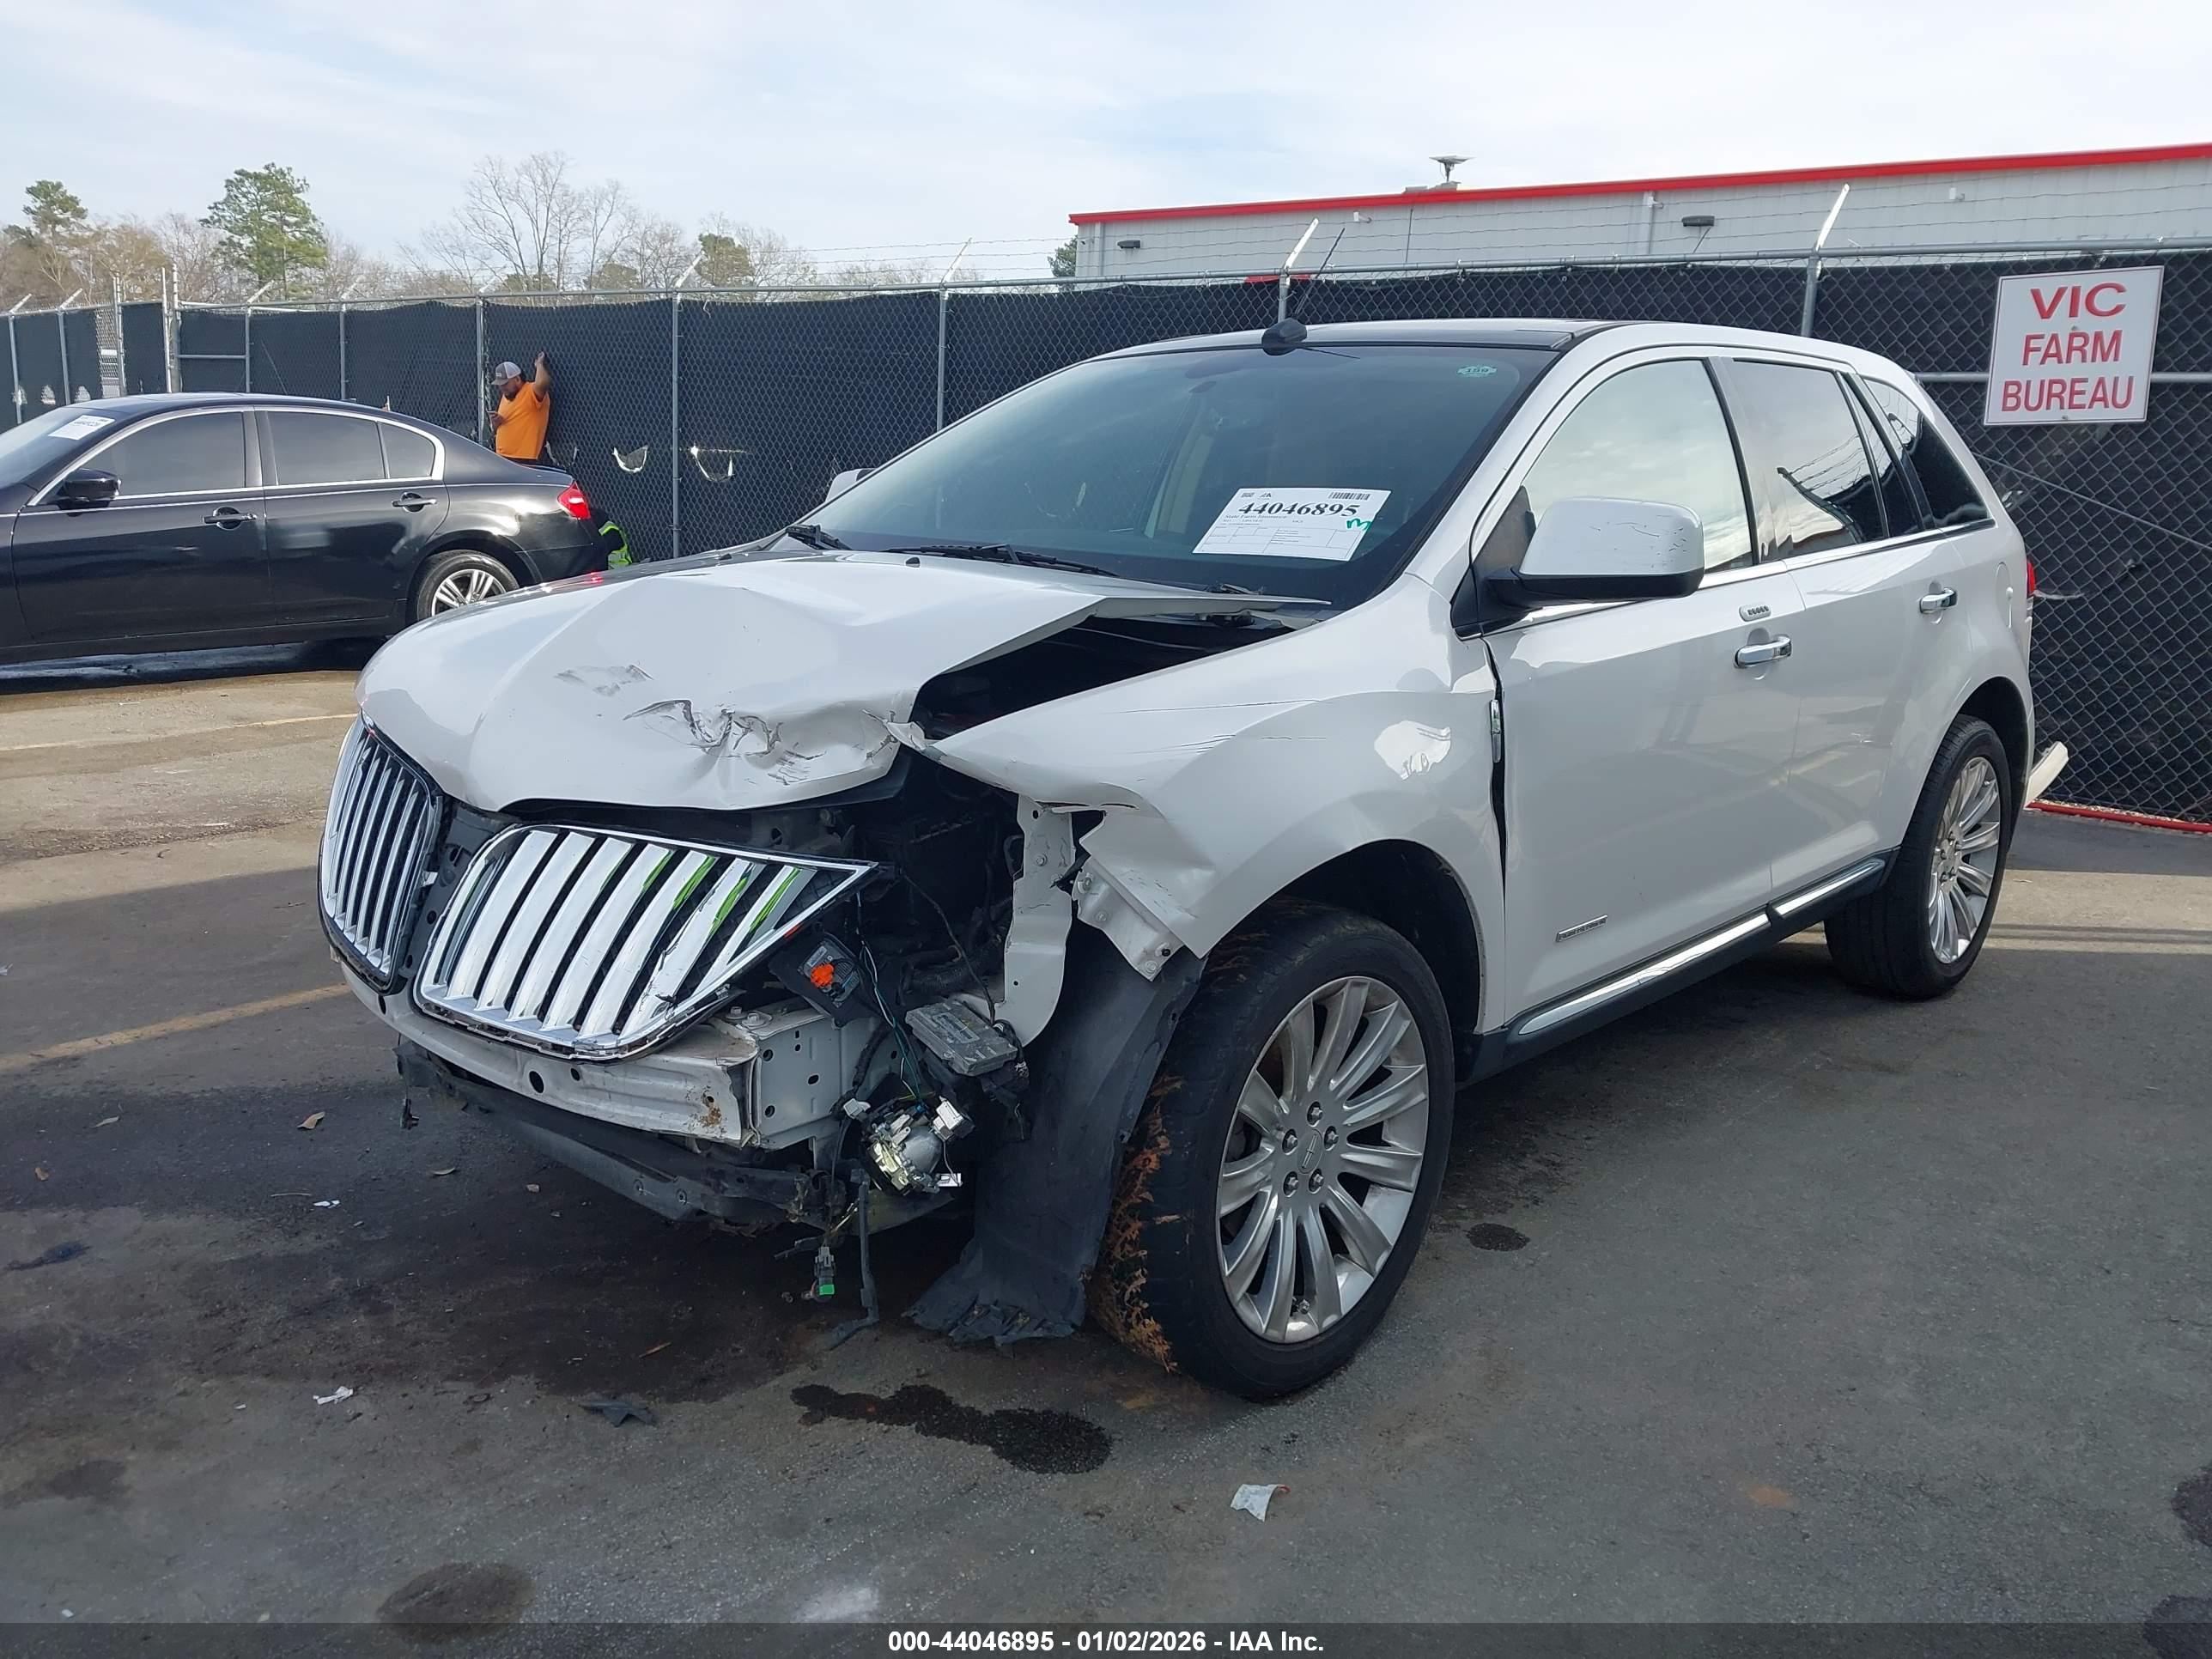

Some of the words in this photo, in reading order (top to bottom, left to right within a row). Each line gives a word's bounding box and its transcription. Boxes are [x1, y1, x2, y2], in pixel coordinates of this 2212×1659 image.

[2030, 283, 2127, 320] VIC
[2022, 330, 2123, 366] FARM
[2001, 376, 2134, 412] BUREAU
[1238, 501, 1360, 517] 44046895
